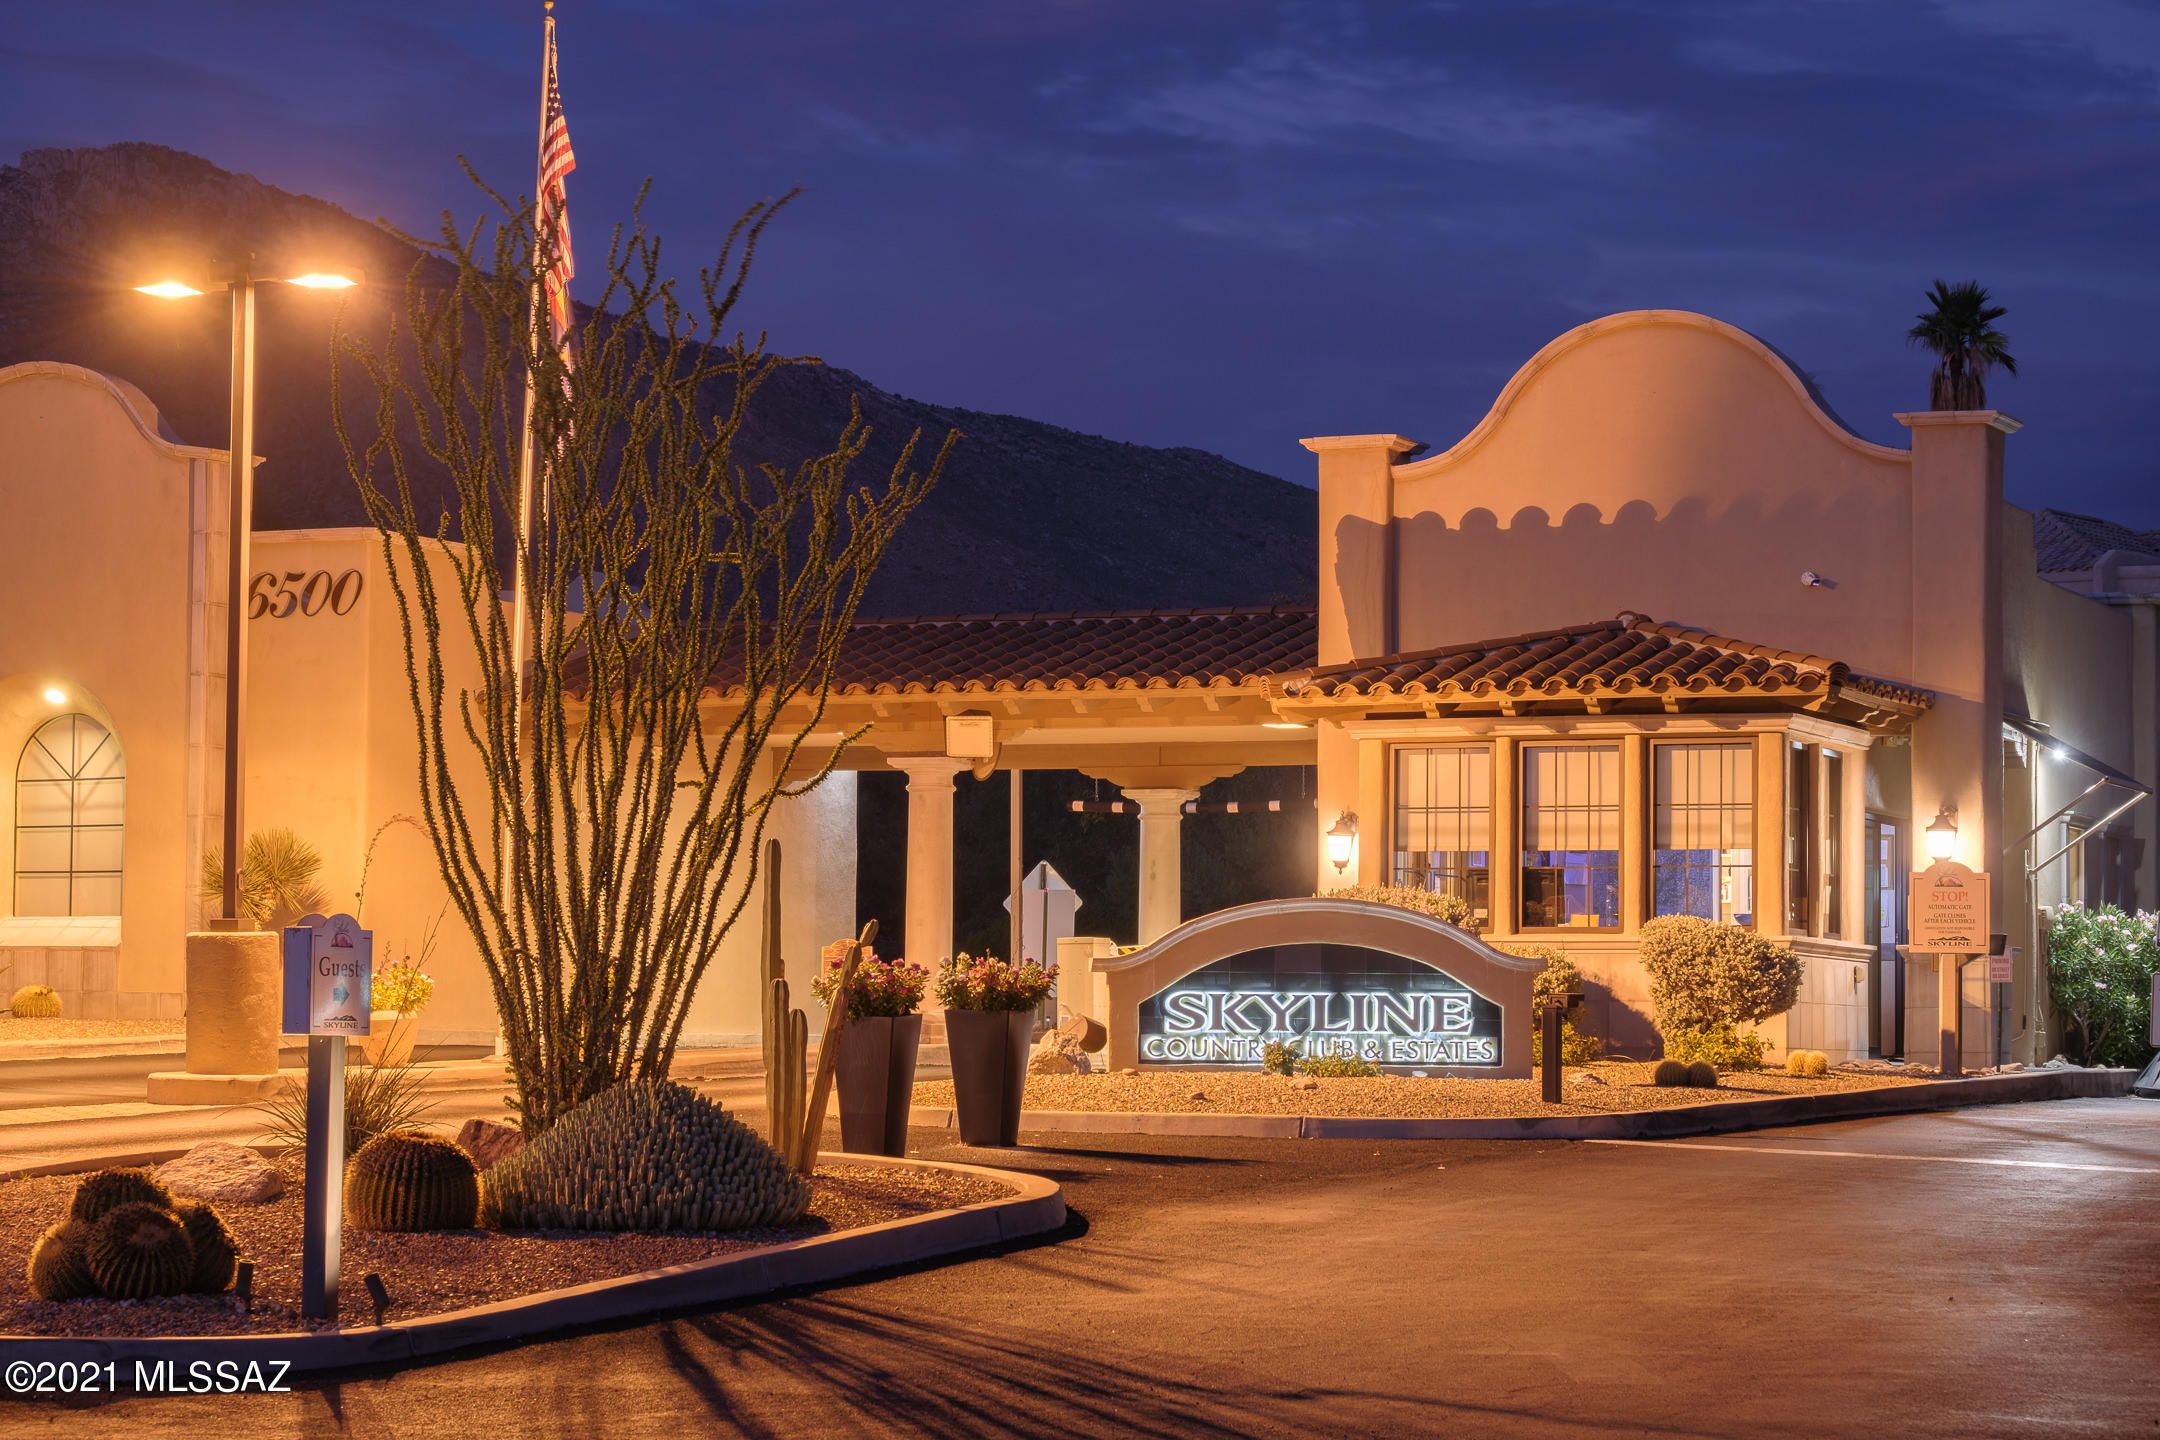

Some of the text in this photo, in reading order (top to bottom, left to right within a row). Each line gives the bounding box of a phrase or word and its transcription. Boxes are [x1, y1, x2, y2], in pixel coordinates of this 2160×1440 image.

[248, 569, 363, 620] 6500
[1931, 890, 1969, 902] STOP!
[319, 956, 367, 978] Guests
[1166, 990, 1474, 1035] SKYLINE
[323, 1021, 359, 1029] SKYLINE
[1145, 1036, 1270, 1059] COUNTR
[1364, 1039, 1381, 1059] &
[1391, 1039, 1494, 1060] ESTATES
